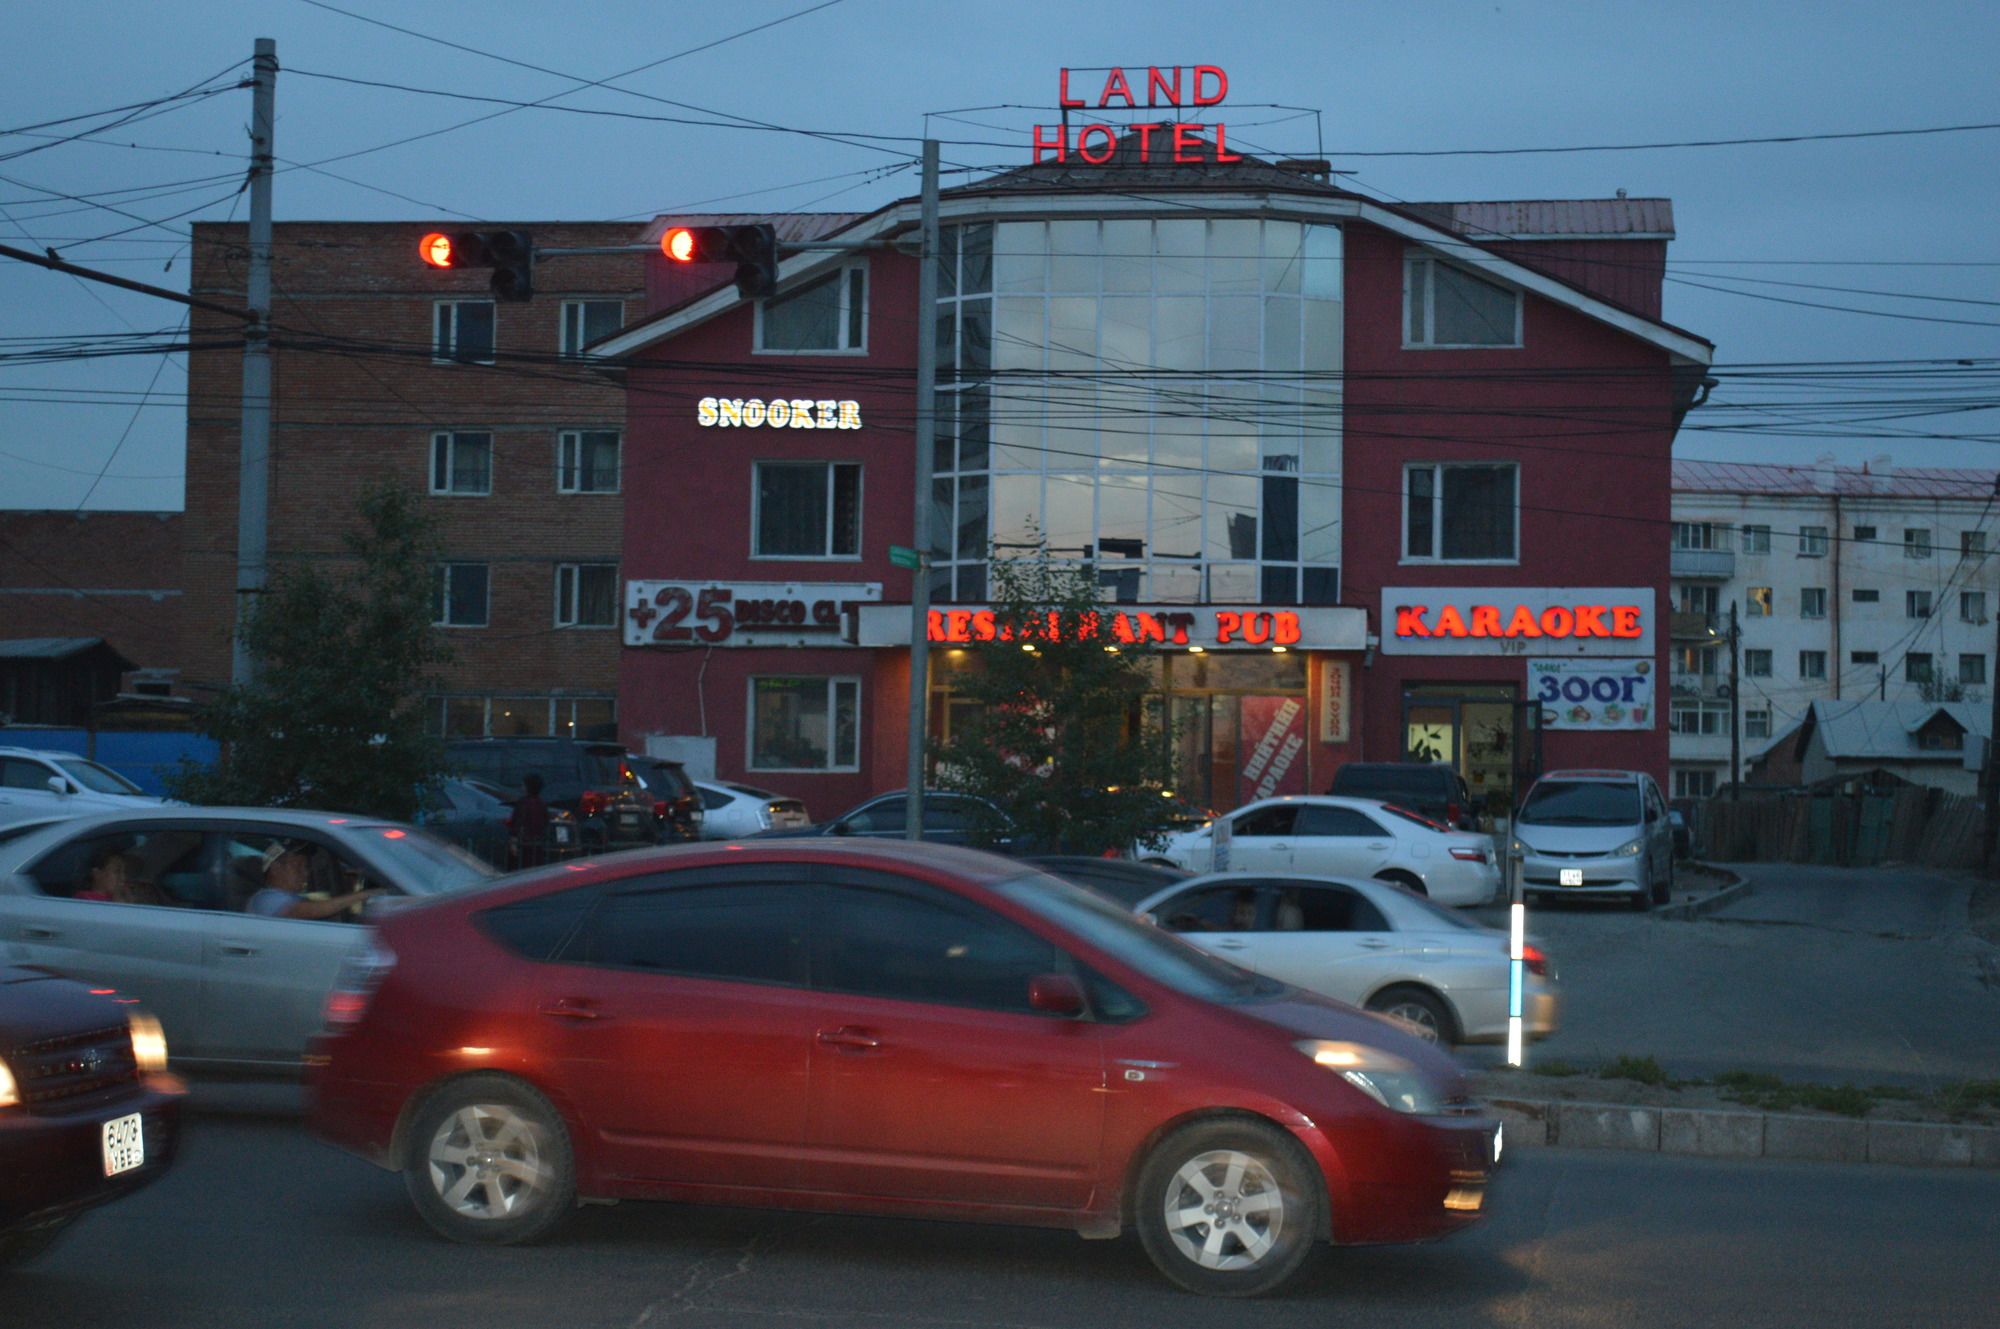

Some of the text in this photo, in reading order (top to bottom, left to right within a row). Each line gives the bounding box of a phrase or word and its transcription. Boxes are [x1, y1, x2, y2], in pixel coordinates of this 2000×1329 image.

[1060, 64, 1229, 107] LAND
[1032, 122, 1243, 165] HOTEL
[697, 397, 862, 429] SNOOKER
[629, 587, 735, 643] +25
[735, 599, 806, 624] DISCO
[927, 609, 1302, 645] RESANT PUB
[1395, 605, 1642, 639] KARAOKE
[1500, 640, 1527, 653] VIP
[107, 1118, 138, 1149] 6473
